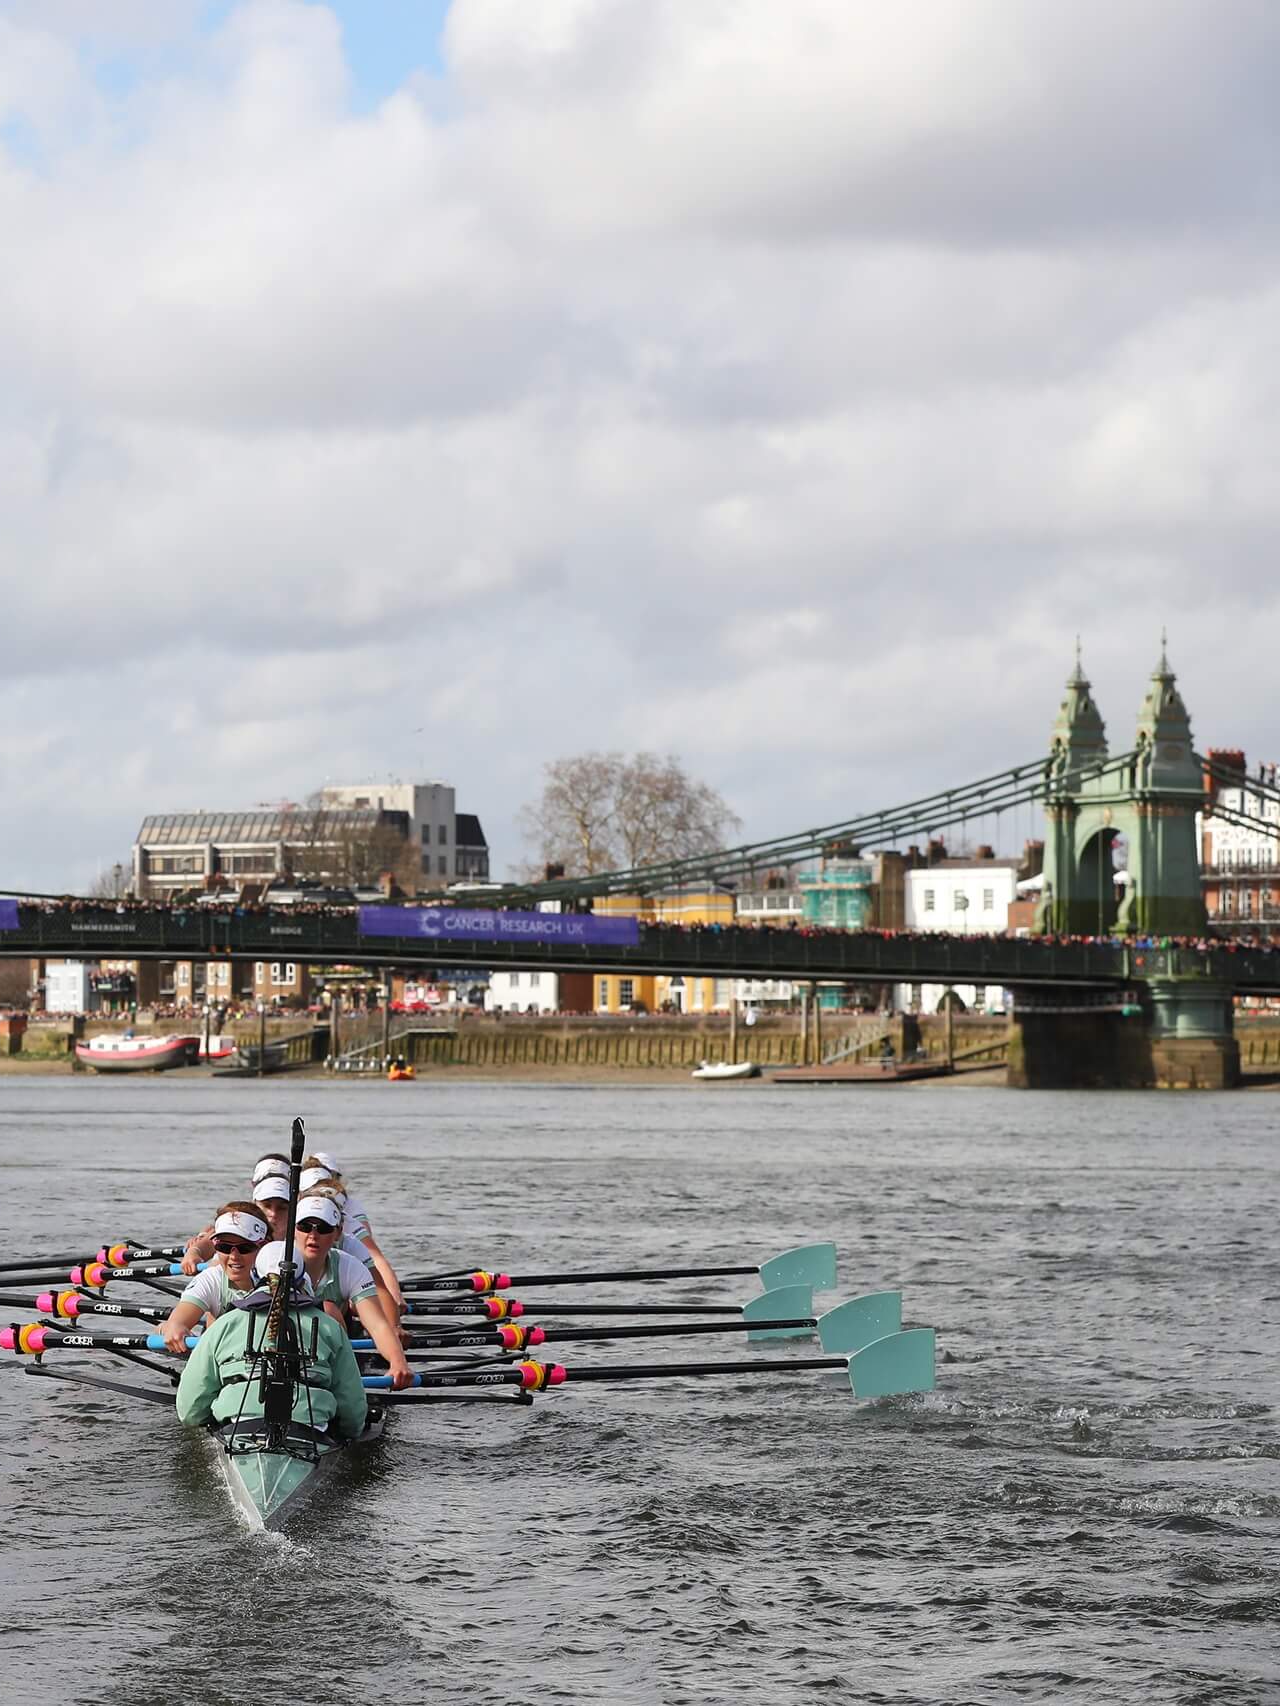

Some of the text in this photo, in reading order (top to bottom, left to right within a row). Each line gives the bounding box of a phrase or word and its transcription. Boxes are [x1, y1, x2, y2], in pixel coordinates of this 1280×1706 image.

[71, 923, 302, 935] HAMMERSMITH BRIDGE
[443, 917, 495, 932] CANCER
[500, 919, 562, 934] RESEARCH
[566, 920, 584, 935] UK
[94, 1303, 122, 1314] CROKER
[62, 1335, 94, 1346] CROKER
[475, 1374, 505, 1383] CROKER
